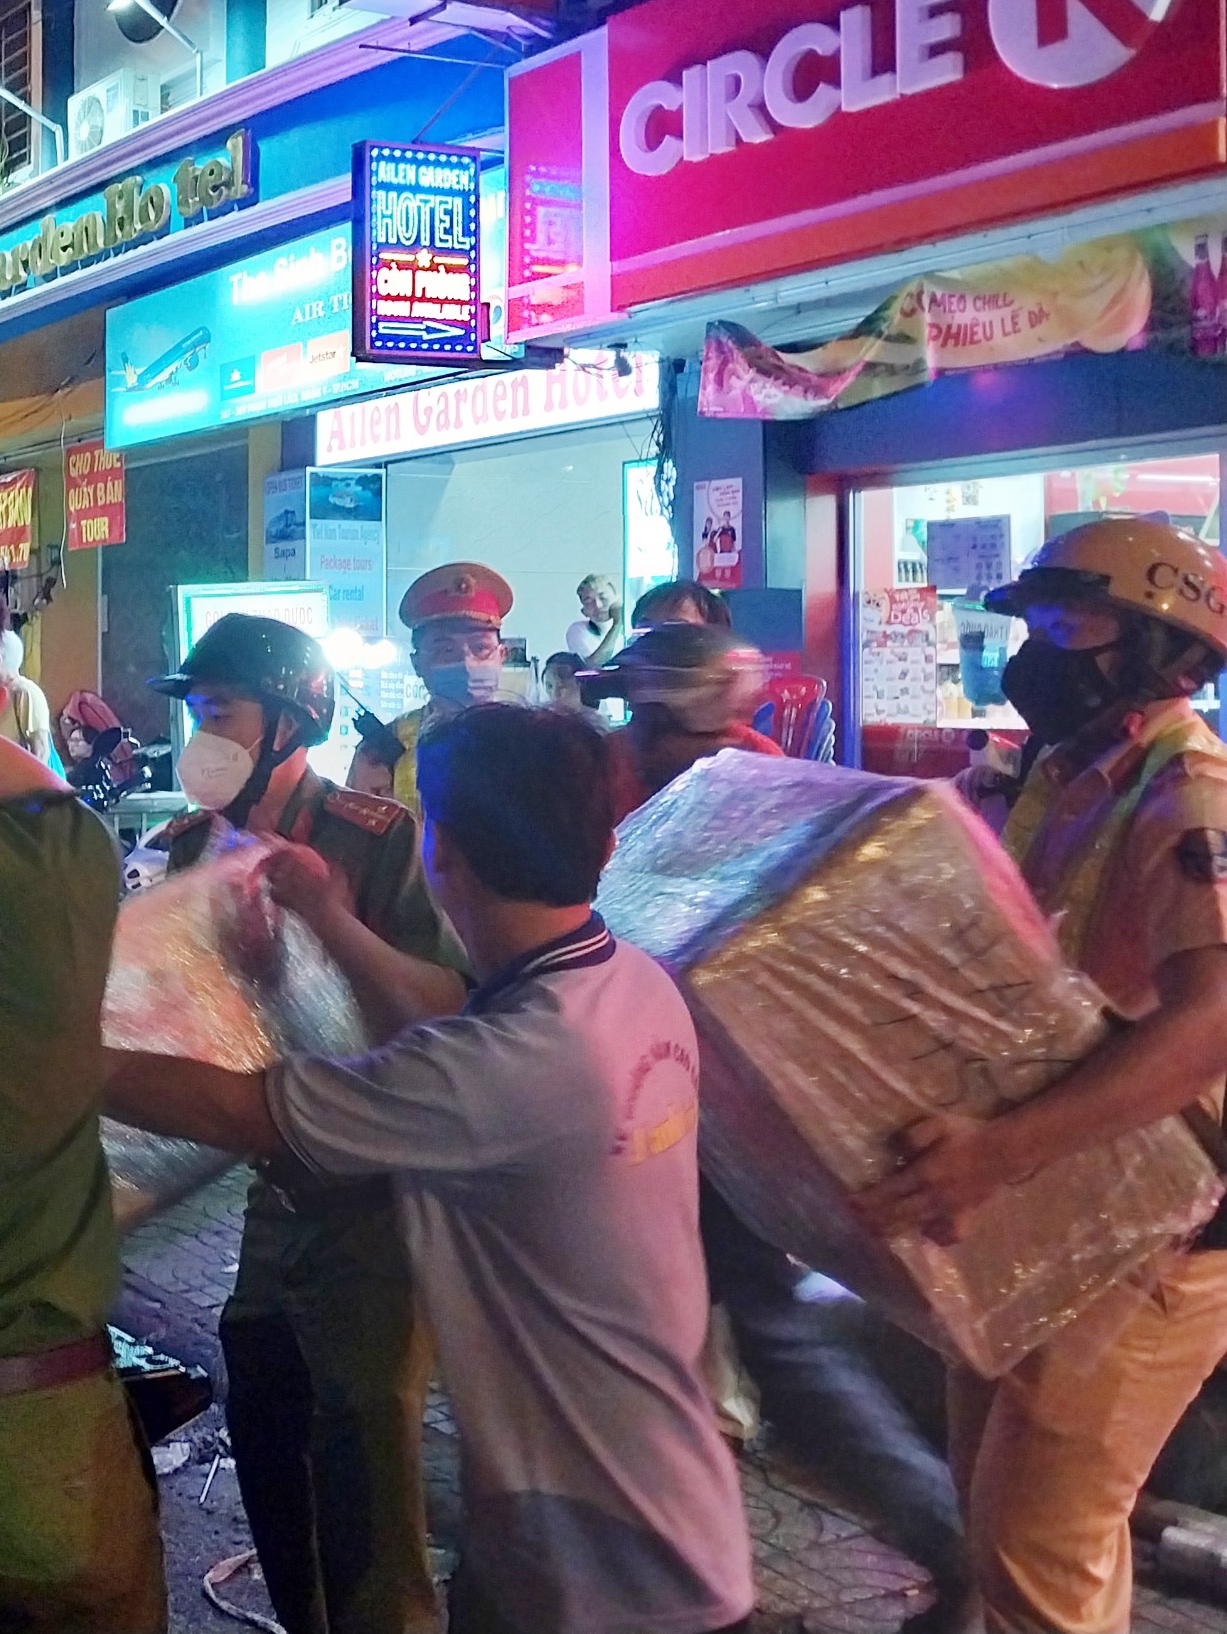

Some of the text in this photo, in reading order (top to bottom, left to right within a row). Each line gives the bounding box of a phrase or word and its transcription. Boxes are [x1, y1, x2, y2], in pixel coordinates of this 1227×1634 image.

[620, 0, 964, 176] CIRCLE
[418, 165, 469, 191] GARDEN
[377, 191, 471, 249] HOTEL
[331, 237, 352, 272] B
[292, 292, 352, 325] AIR TI
[309, 350, 336, 364] Jetstar
[413, 370, 530, 436] Garden
[69, 452, 91, 478] CHO
[97, 476, 122, 506] BÁN
[81, 516, 109, 543] TOUR
[274, 546, 296, 560] Sapa
[320, 554, 372, 574] Package tours
[343, 585, 364, 601] rental
